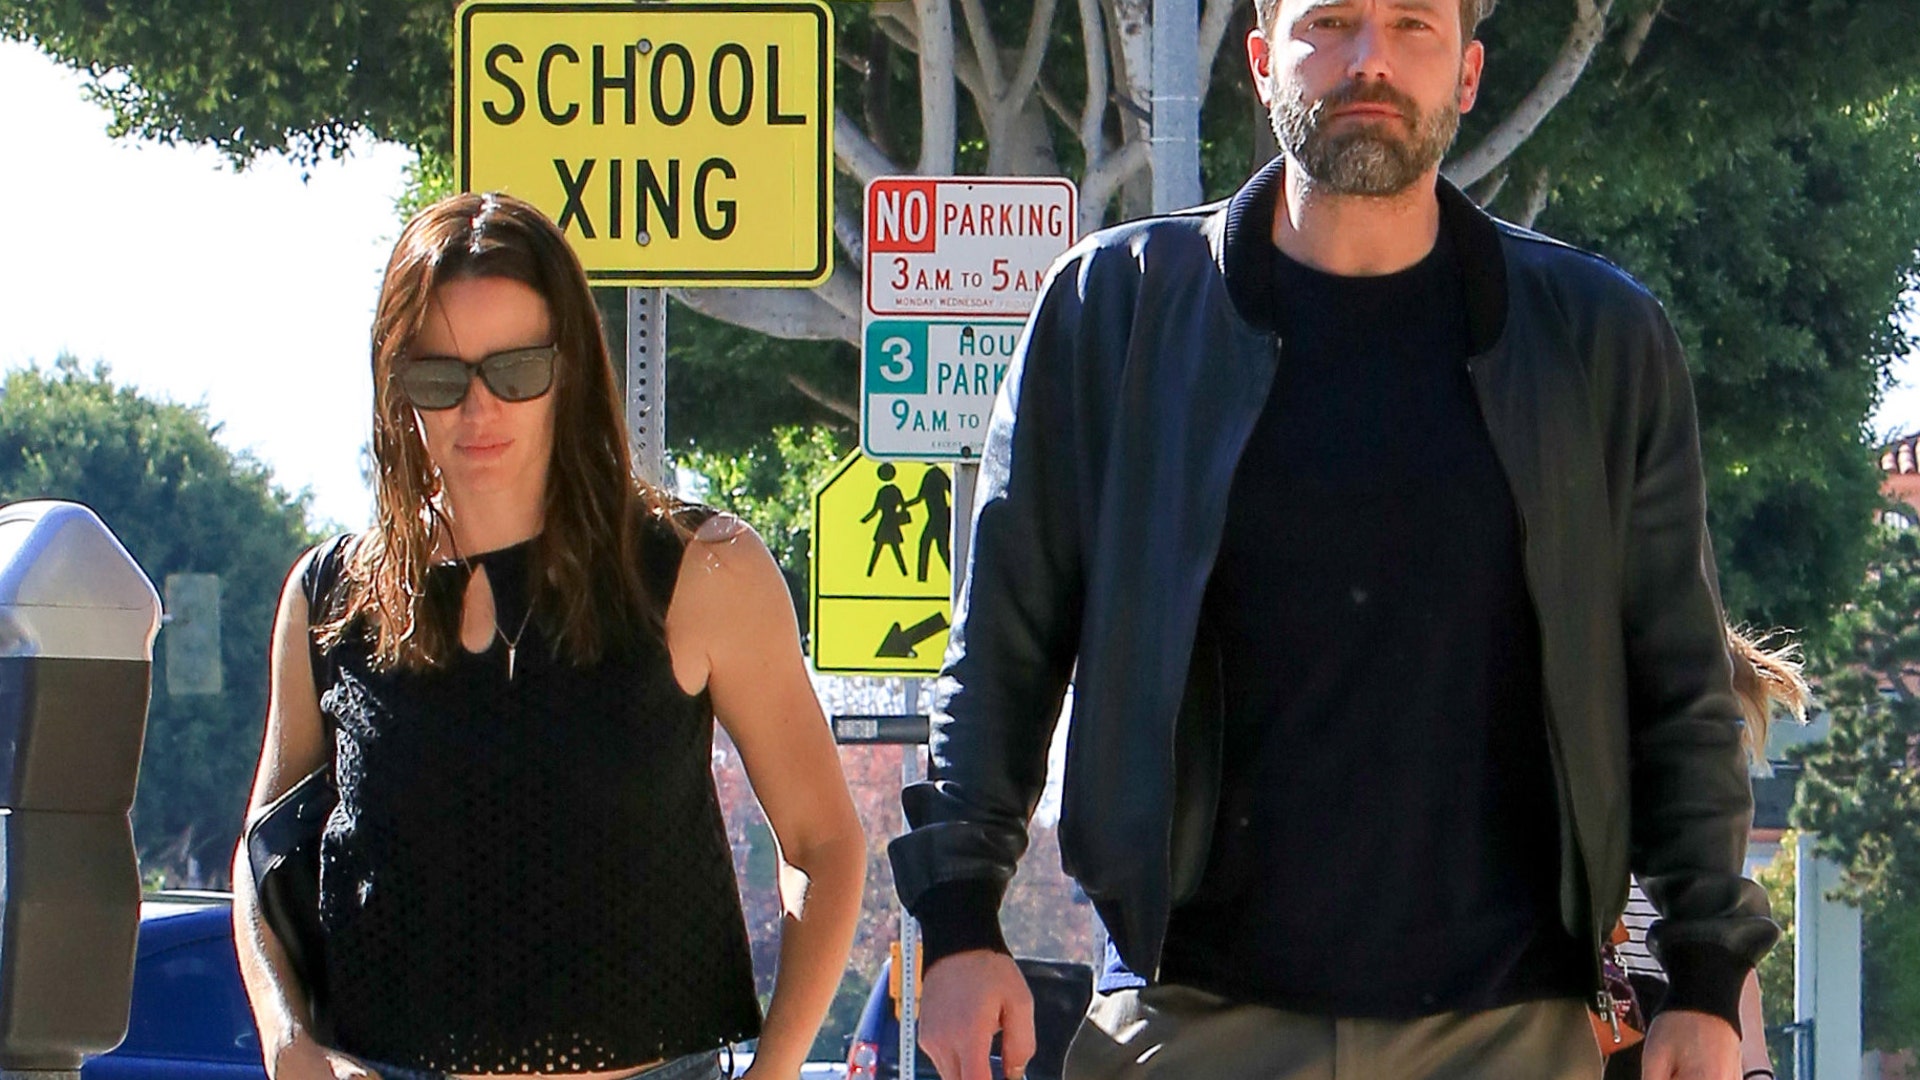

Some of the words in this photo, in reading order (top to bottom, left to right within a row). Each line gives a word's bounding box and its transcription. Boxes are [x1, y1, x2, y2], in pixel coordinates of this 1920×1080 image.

[481, 42, 807, 127] SCHOOL
[553, 157, 737, 241] XING
[876, 188, 929, 243] NO
[943, 203, 1063, 237] PARKING
[961, 271, 983, 288] TO
[879, 336, 915, 383] 3
[959, 334, 1015, 357] HOU
[937, 362, 1008, 396] PARK
[958, 413, 980, 429] TO
